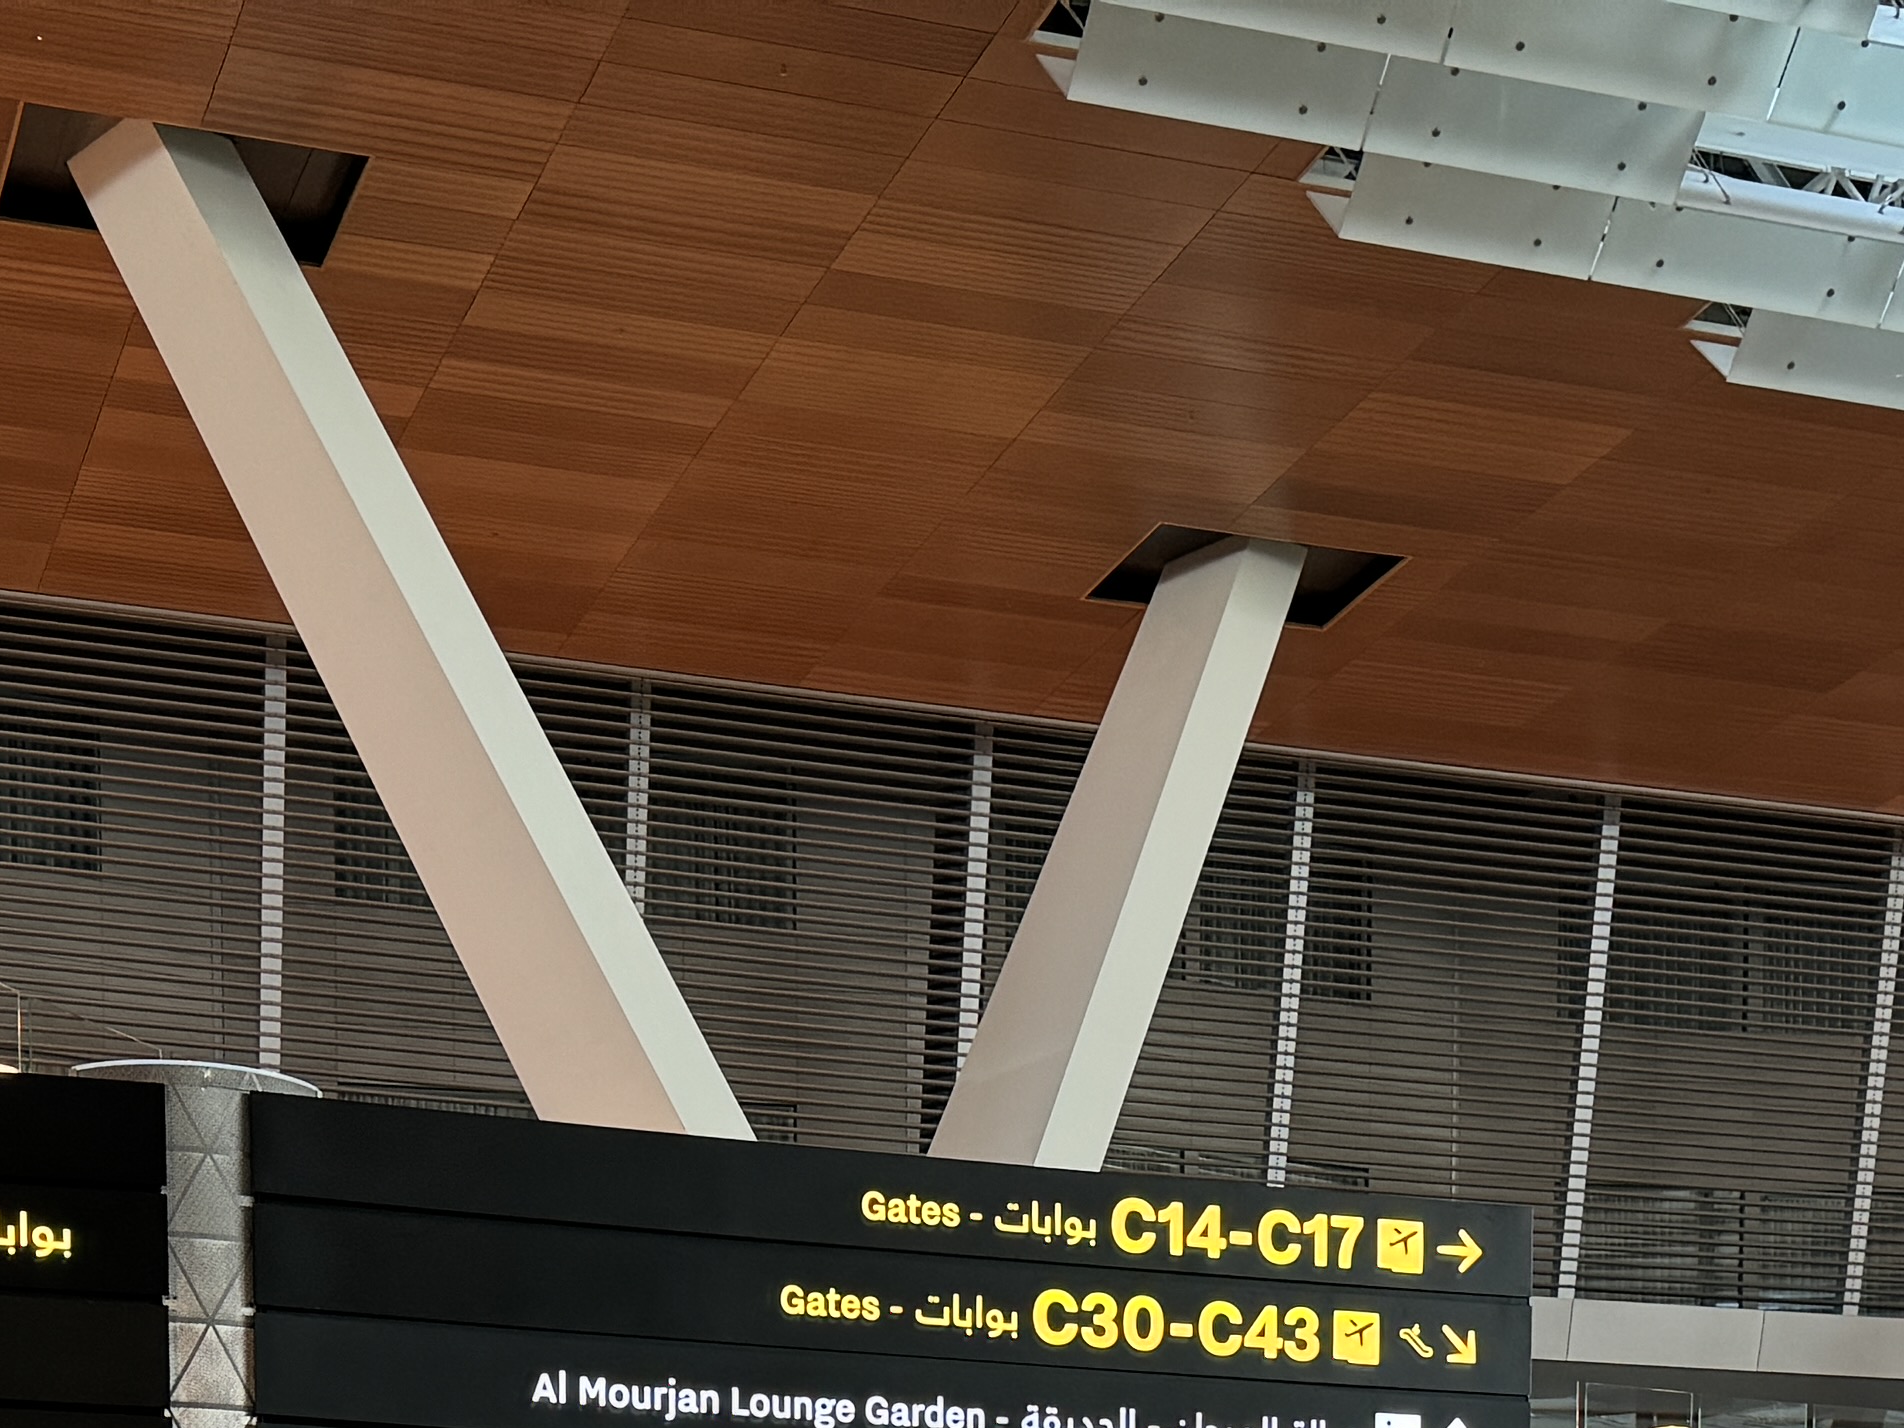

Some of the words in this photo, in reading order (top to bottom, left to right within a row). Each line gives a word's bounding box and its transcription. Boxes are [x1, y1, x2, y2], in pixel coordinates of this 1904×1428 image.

[862, 1191, 960, 1227] Gates
[995, 1201, 1096, 1246] بوابات
[1111, 1197, 1364, 1269] C14-C17
[781, 1285, 880, 1321] Gates
[915, 1293, 1018, 1339] بوابات
[1033, 1289, 1320, 1362] C30-C43
[532, 1370, 566, 1404] Al
[579, 1376, 719, 1421] Mourjan
